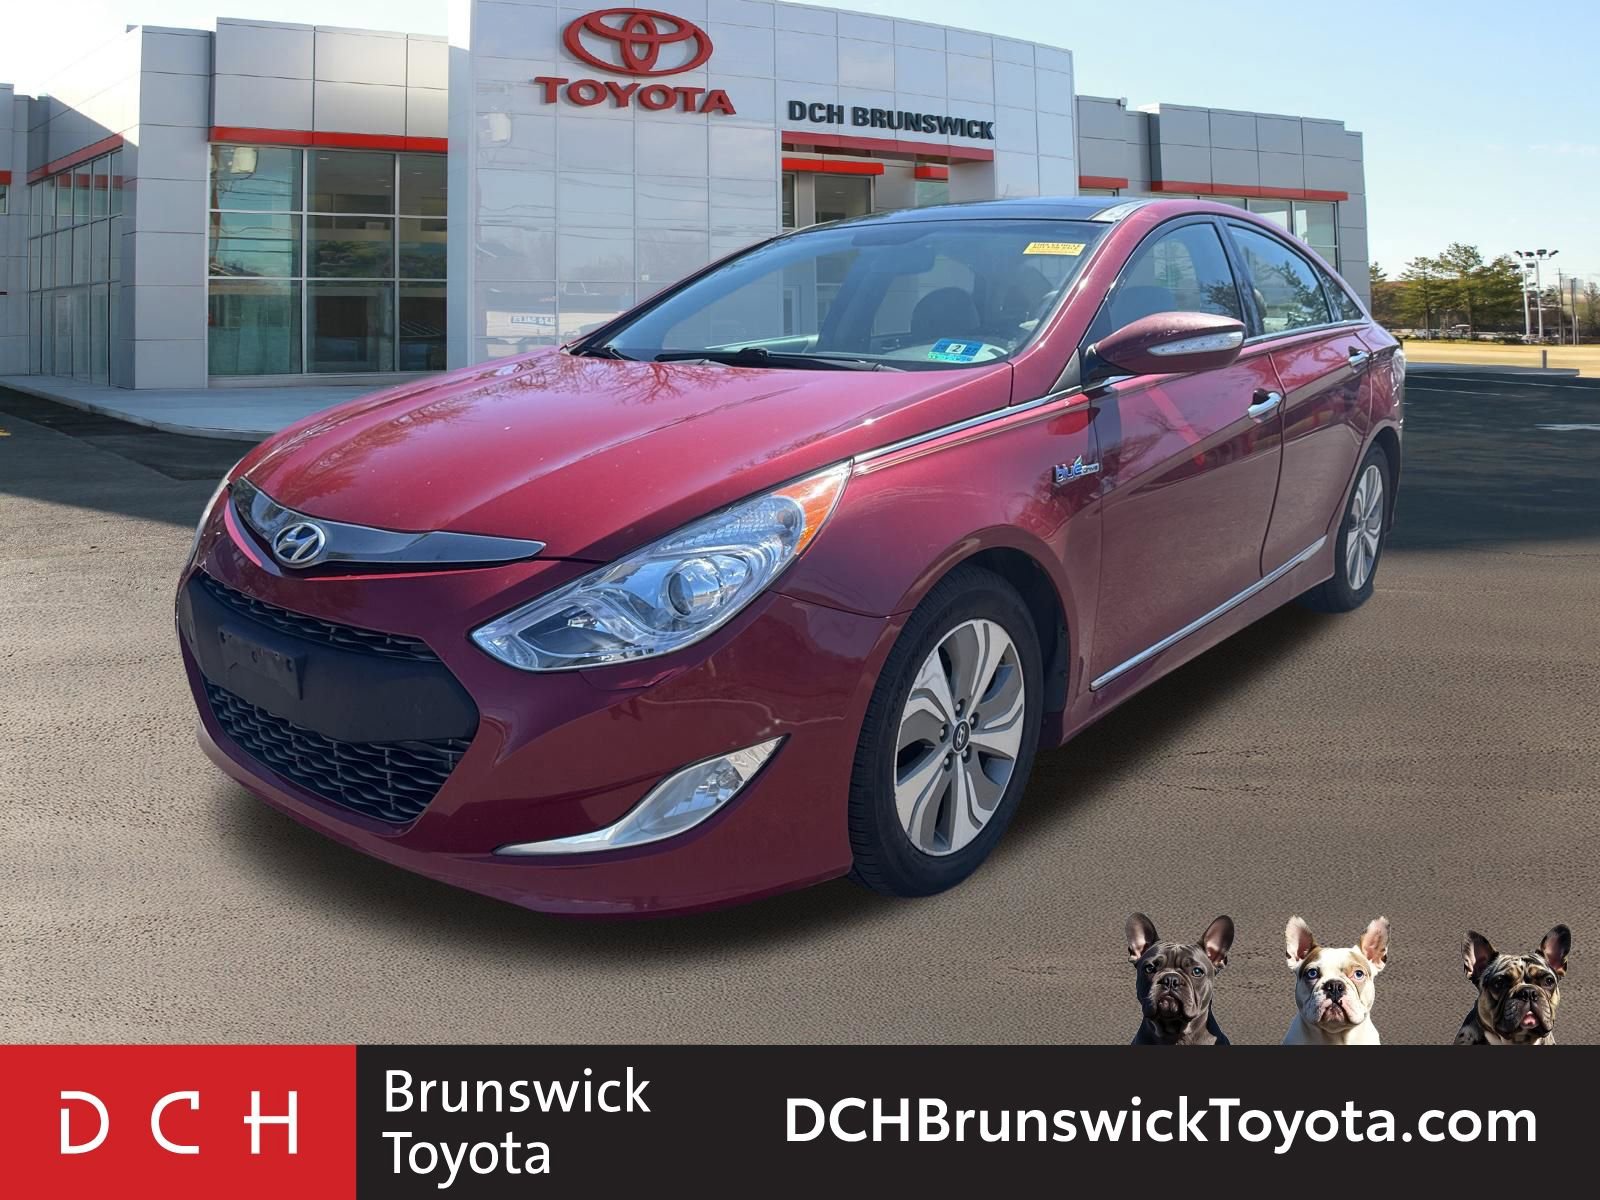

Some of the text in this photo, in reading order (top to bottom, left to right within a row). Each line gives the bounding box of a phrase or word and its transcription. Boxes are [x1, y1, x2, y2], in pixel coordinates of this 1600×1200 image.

[534, 76, 736, 115] TOYOTA
[788, 100, 995, 141] DCH BRUNSWICK
